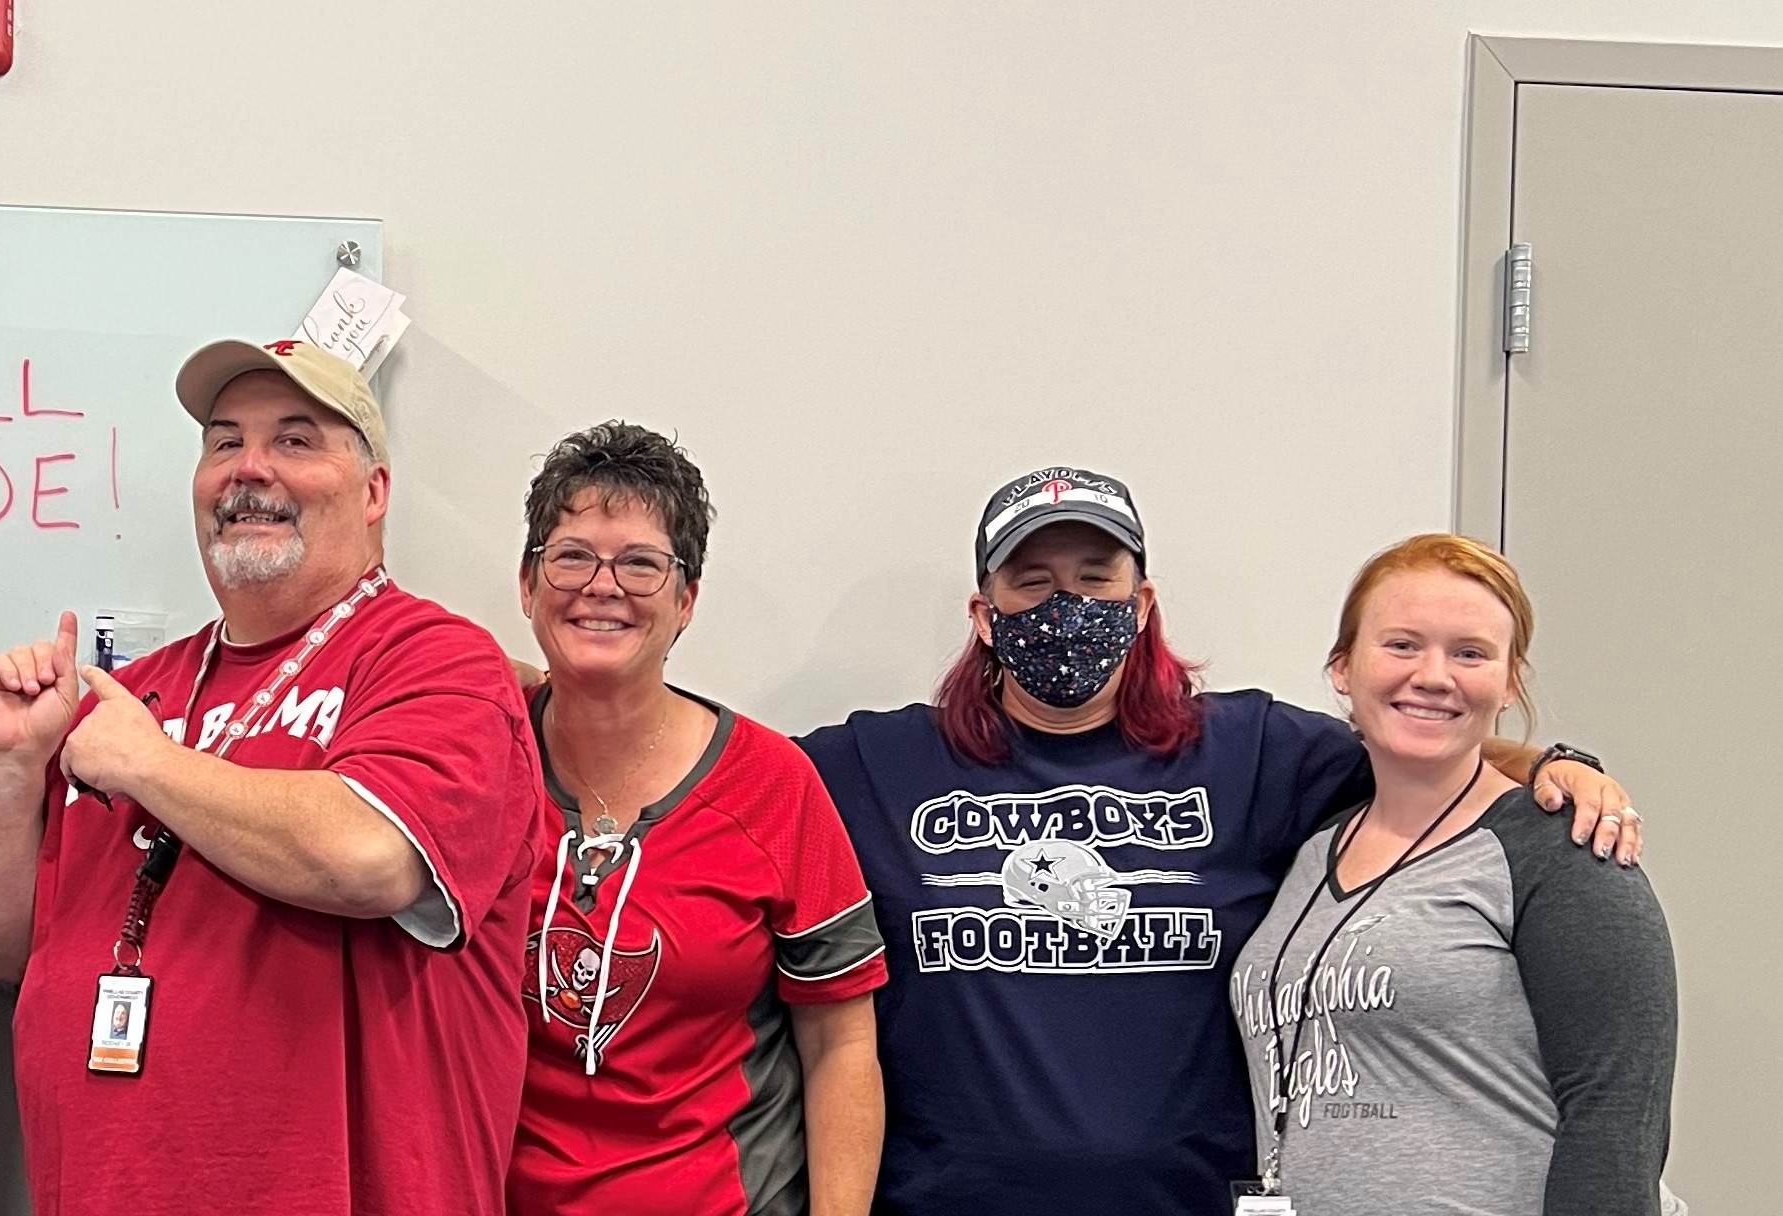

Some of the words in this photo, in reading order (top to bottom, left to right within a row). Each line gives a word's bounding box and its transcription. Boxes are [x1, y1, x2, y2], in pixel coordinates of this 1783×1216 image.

[910, 784, 1214, 854] COWBOYS
[911, 907, 1222, 974] FOOTBALL
[1324, 1103, 1398, 1119] FOOTBALL
